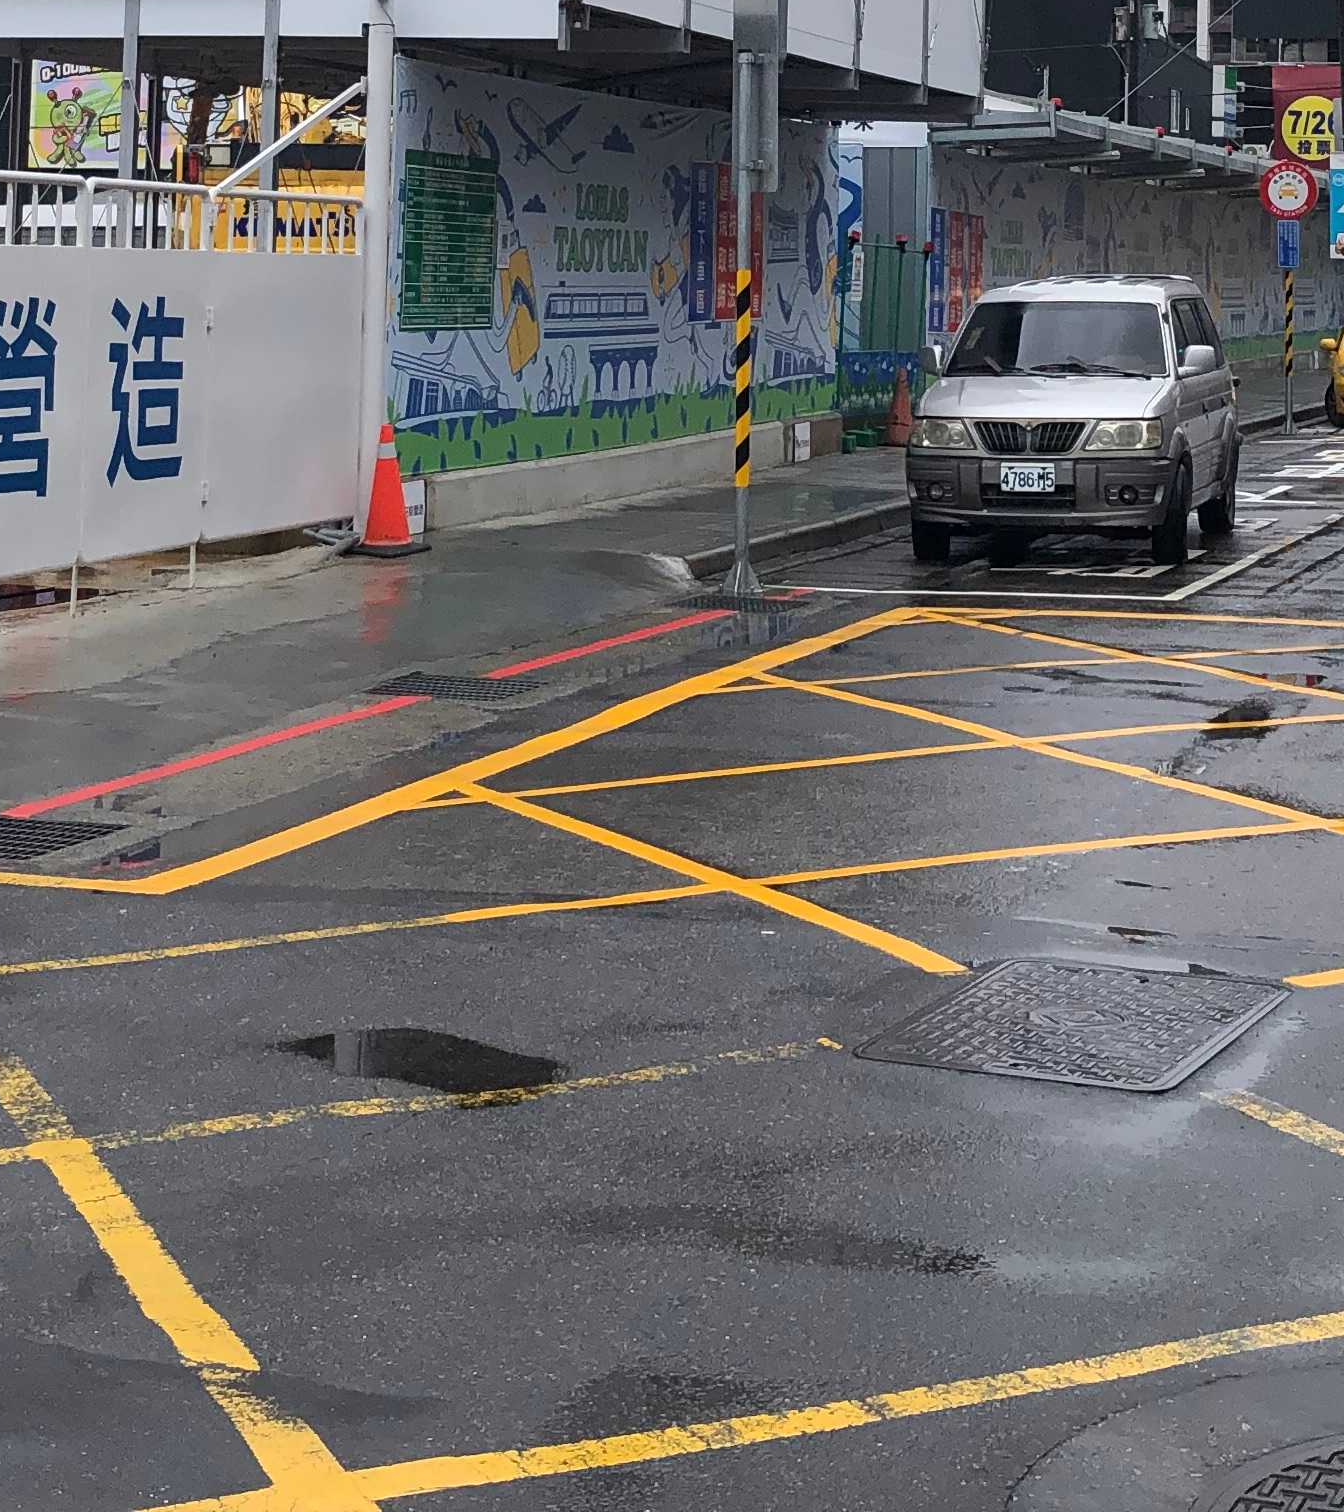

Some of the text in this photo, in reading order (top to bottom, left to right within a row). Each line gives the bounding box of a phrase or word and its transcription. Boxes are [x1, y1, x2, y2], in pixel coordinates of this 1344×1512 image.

[1297, 139, 1331, 156] 投票
[575, 182, 630, 223] LOHAS
[554, 226, 649, 273] TAOYUAN
[1002, 471, 1054, 489] 4786-M5
